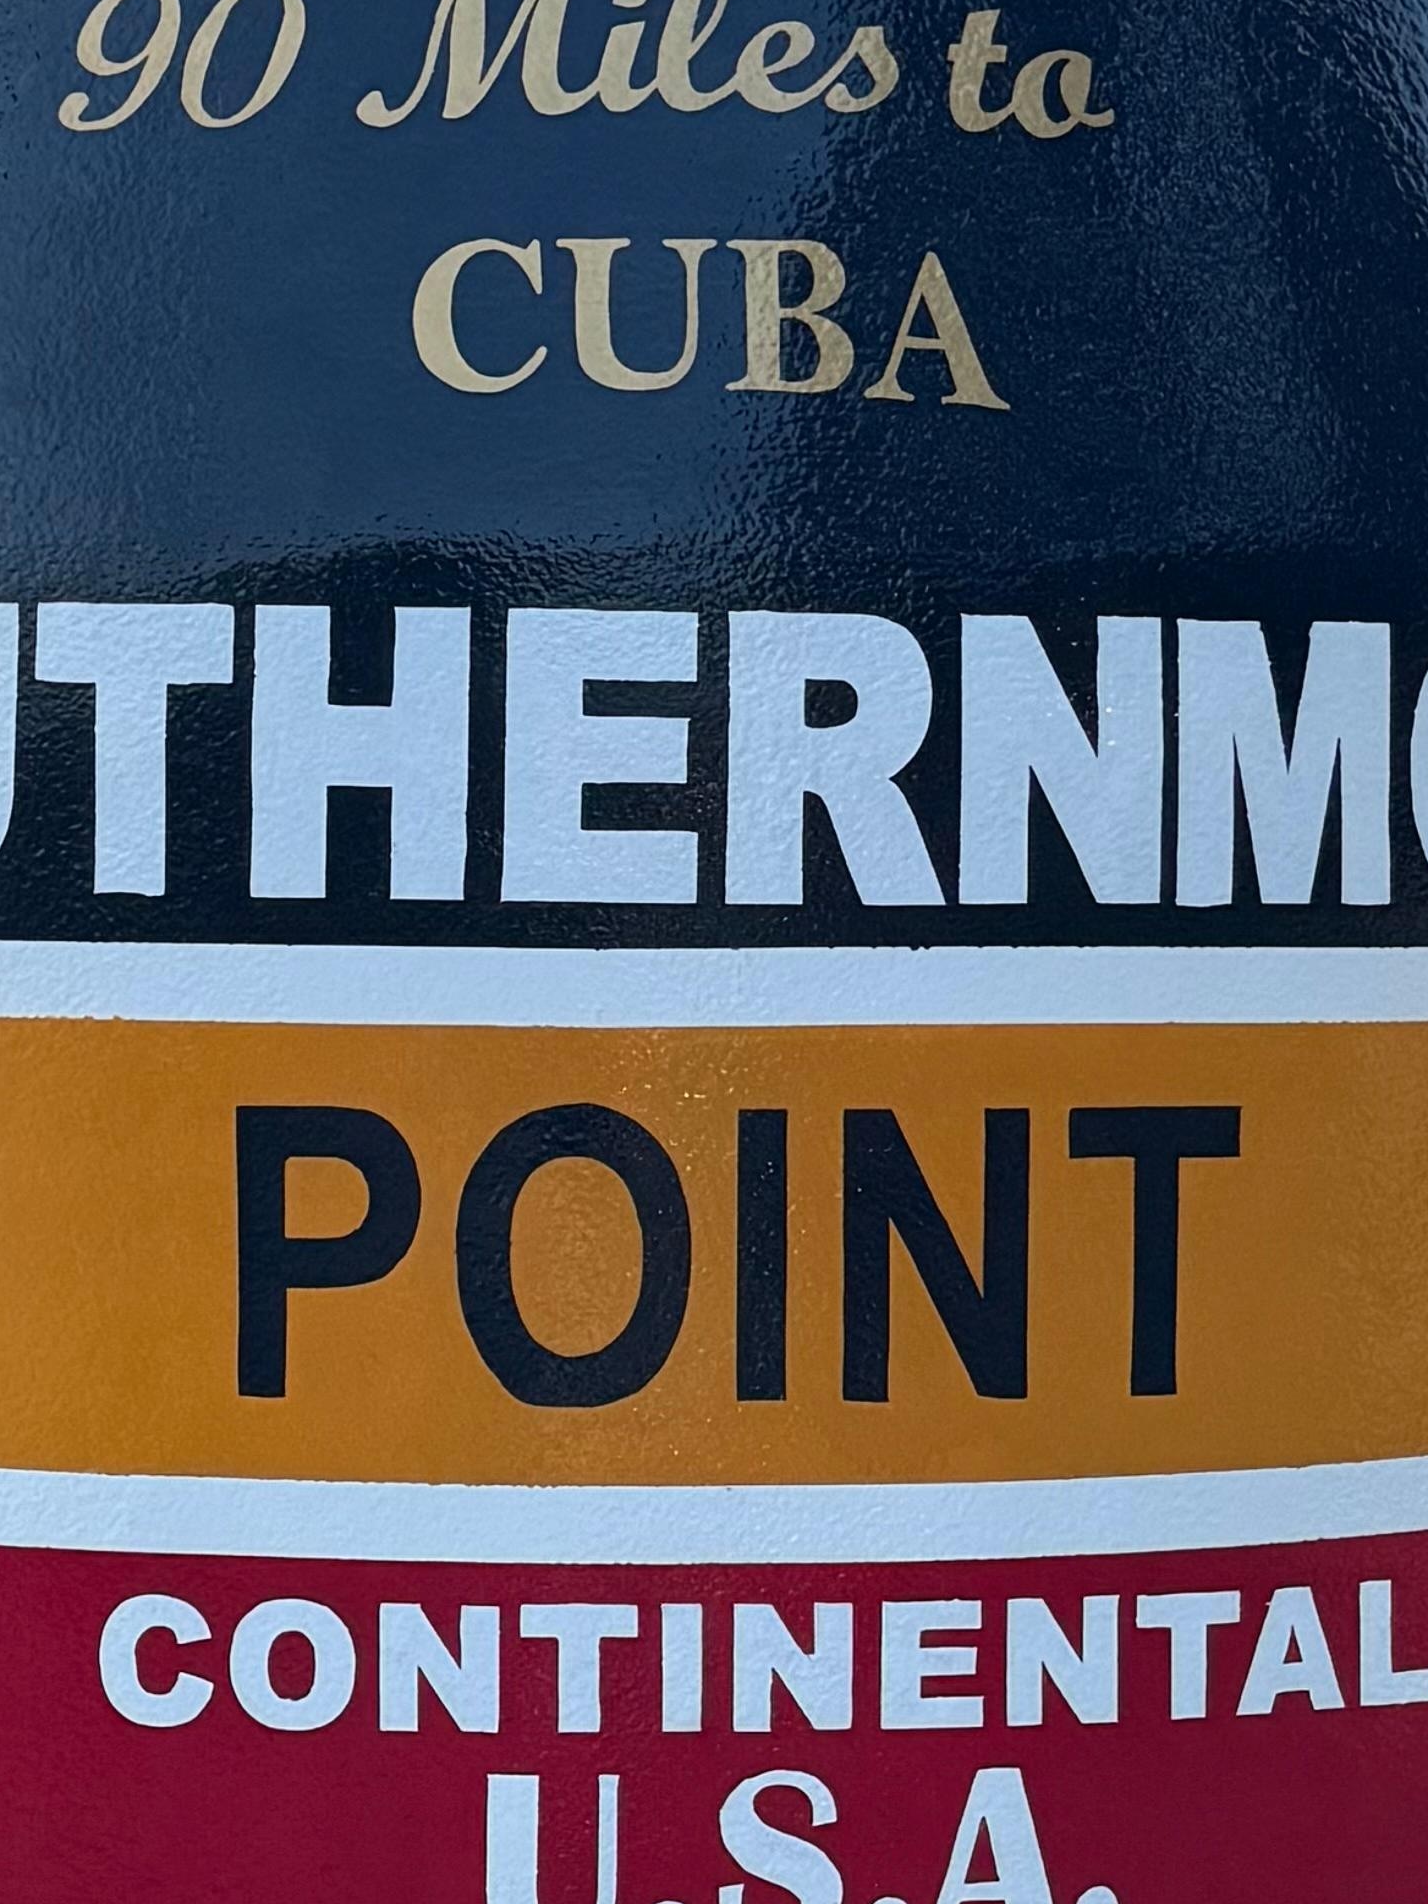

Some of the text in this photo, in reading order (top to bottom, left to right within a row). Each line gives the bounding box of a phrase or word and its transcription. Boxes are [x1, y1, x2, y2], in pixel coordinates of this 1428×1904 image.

[945, 8, 1116, 139] to
[412, 237, 1012, 412] CUBA
[234, 1102, 1243, 1409] POINT
